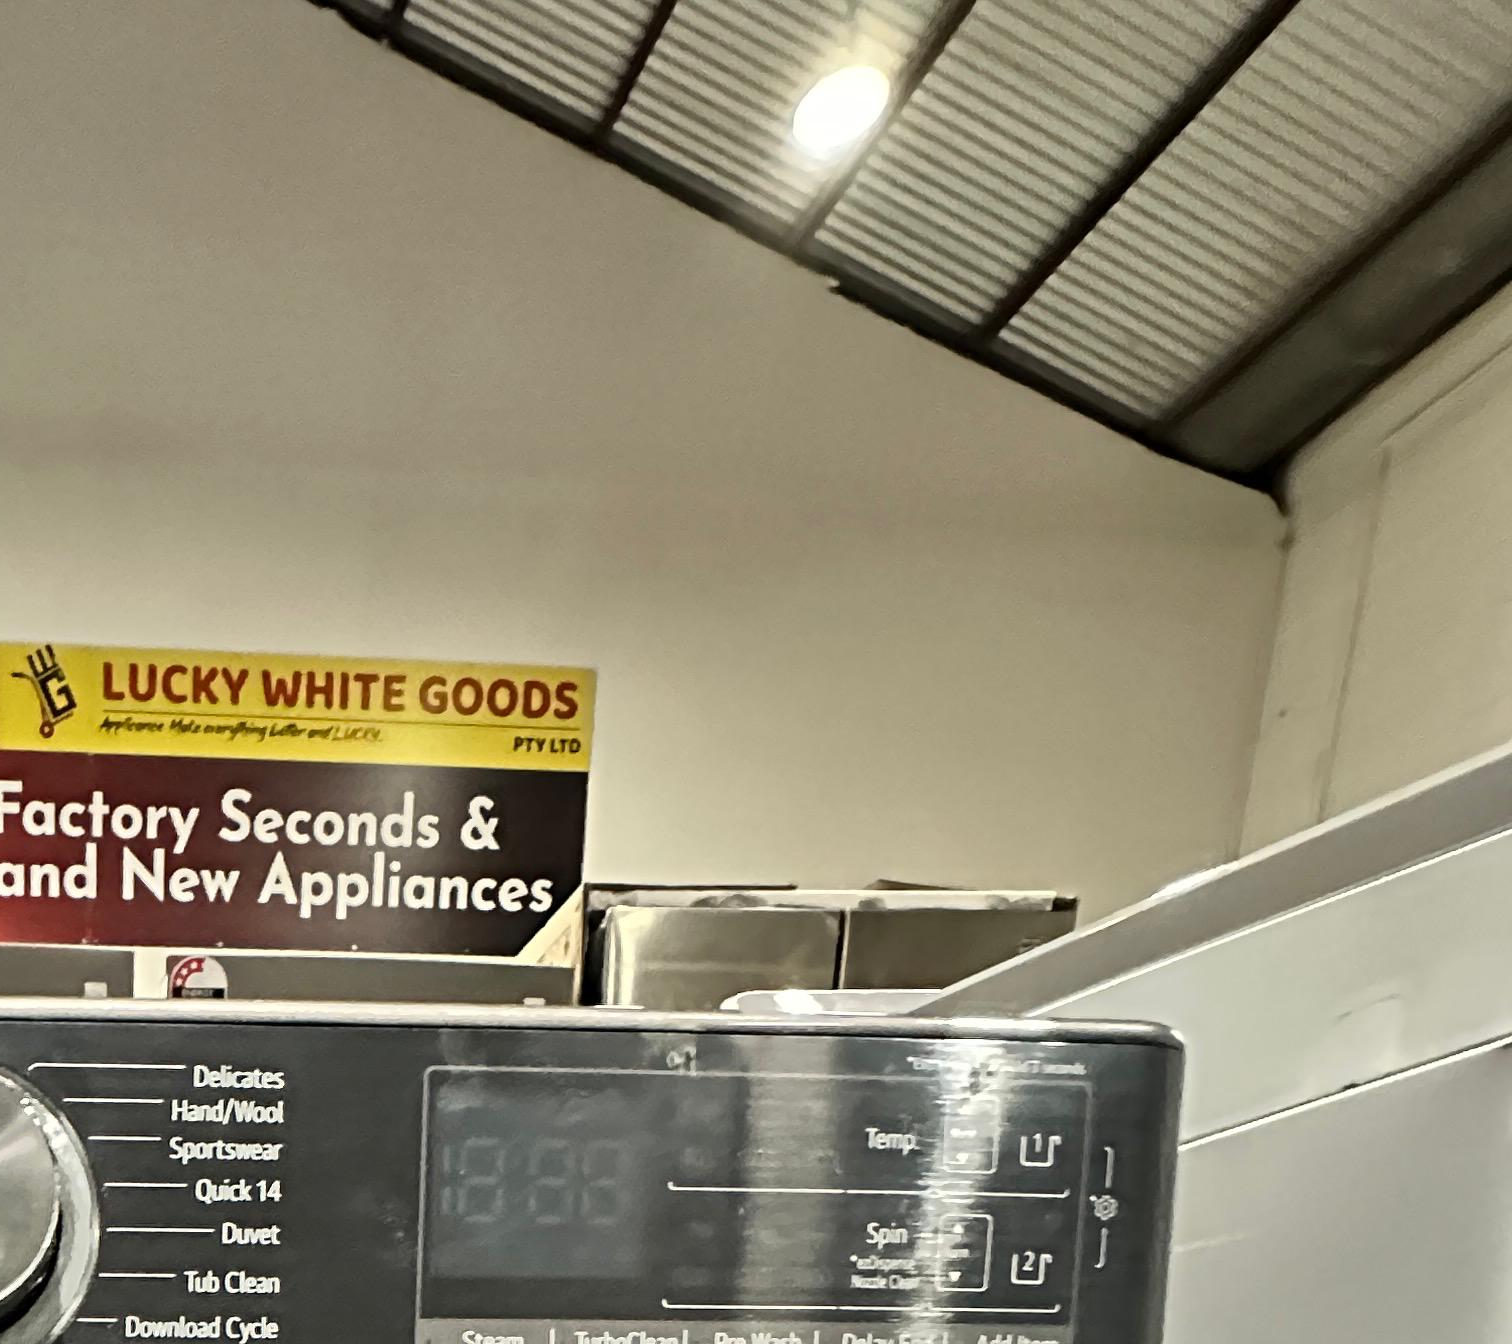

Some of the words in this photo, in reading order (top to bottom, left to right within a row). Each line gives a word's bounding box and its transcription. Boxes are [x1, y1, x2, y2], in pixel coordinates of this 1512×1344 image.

[101, 661, 249, 705] LUCKY
[262, 668, 406, 712] WHITE
[418, 674, 580, 721] GOODS
[513, 736, 547, 754] PTY
[549, 737, 582, 755] LTD
[219, 788, 440, 850] Seconds
[460, 795, 500, 852] &
[122, 847, 241, 903] New
[258, 850, 554, 920] Appliances
[193, 1065, 286, 1090] Delicates
[171, 1099, 284, 1125] Hand/Wool
[169, 1137, 283, 1165] Sportswear
[865, 1127, 920, 1155] Temp.
[195, 1179, 252, 1205] Quick
[255, 1180, 282, 1202] 14
[222, 1222, 281, 1246] Duvet
[866, 1222, 909, 1250] Spin
[1022, 1250, 1036, 1271] 2
[183, 1270, 221, 1294] Tub
[224, 1271, 281, 1295] Clean
[125, 1316, 221, 1340] Download
[225, 1316, 279, 1344] Cycle
